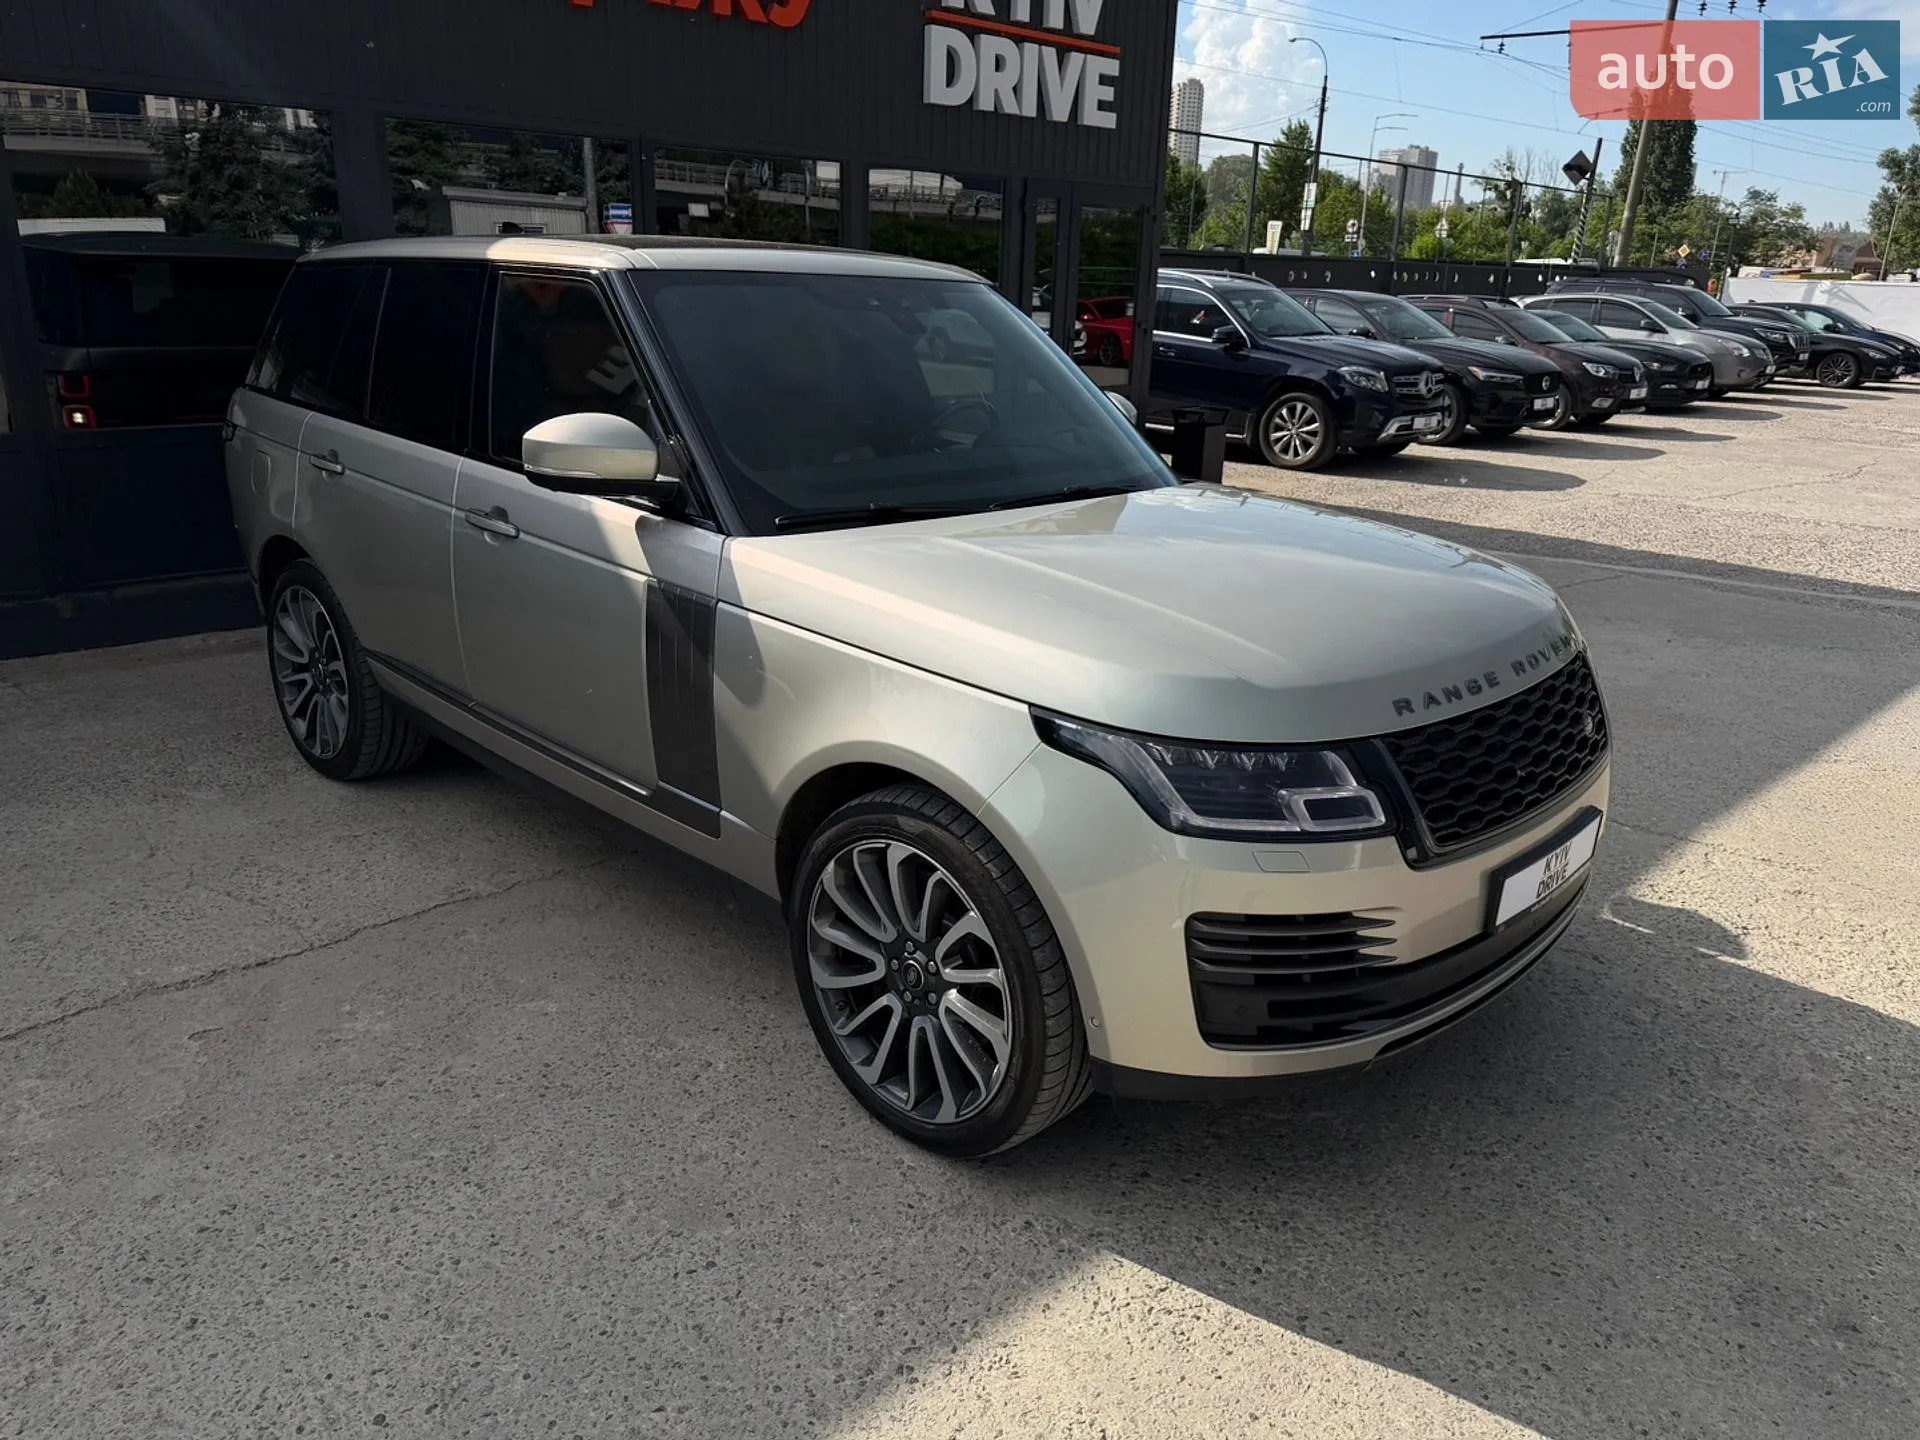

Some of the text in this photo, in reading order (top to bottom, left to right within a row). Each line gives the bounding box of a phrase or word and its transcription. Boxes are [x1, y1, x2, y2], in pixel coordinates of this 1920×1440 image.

[923, 24, 1120, 129] DRIVE
[1391, 670, 1501, 717] RANGE
[1543, 841, 1572, 875] KYIV
[1535, 868, 1568, 899] DRIVE
